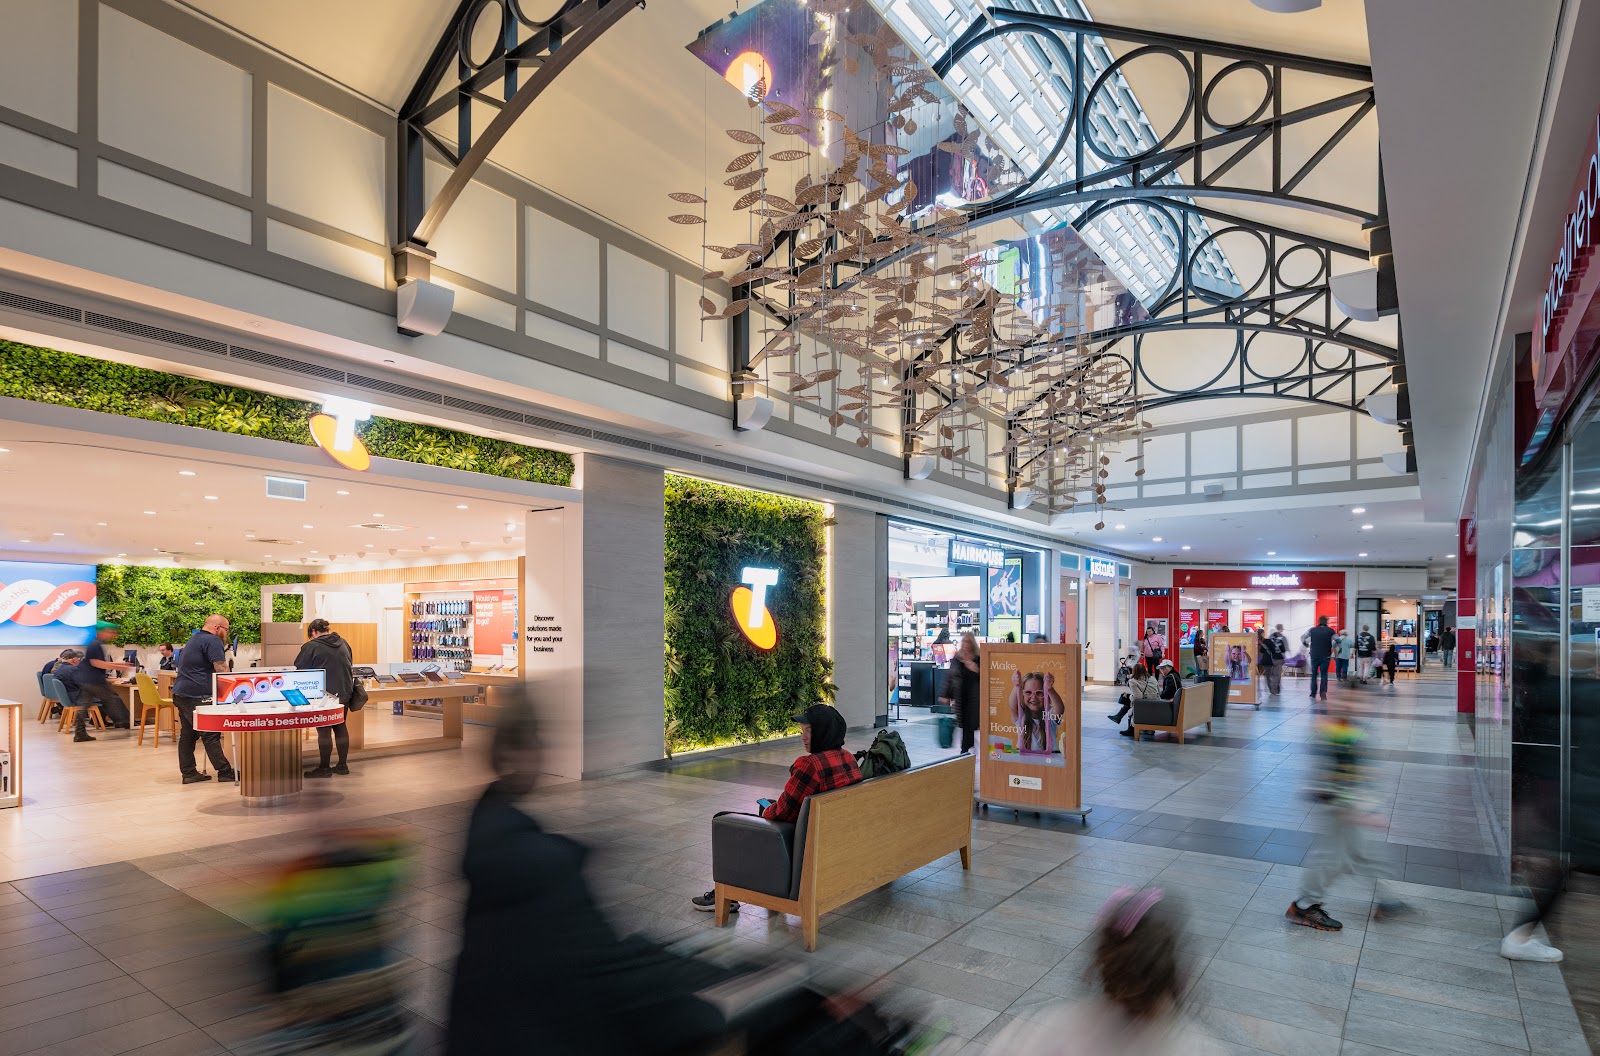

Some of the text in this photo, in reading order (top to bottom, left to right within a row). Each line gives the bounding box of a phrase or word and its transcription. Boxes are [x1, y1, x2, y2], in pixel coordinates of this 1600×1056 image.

[1542, 190, 1585, 354] priceline
[952, 544, 1004, 569] HAIRHOUSE
[1251, 573, 1299, 586] medibank
[41, 588, 80, 616] together
[742, 567, 779, 629] T
[223, 718, 275, 728] Australia's
[275, 716, 299, 727] best
[300, 714, 327, 725] mobile
[990, 722, 1027, 736] Hooray!
